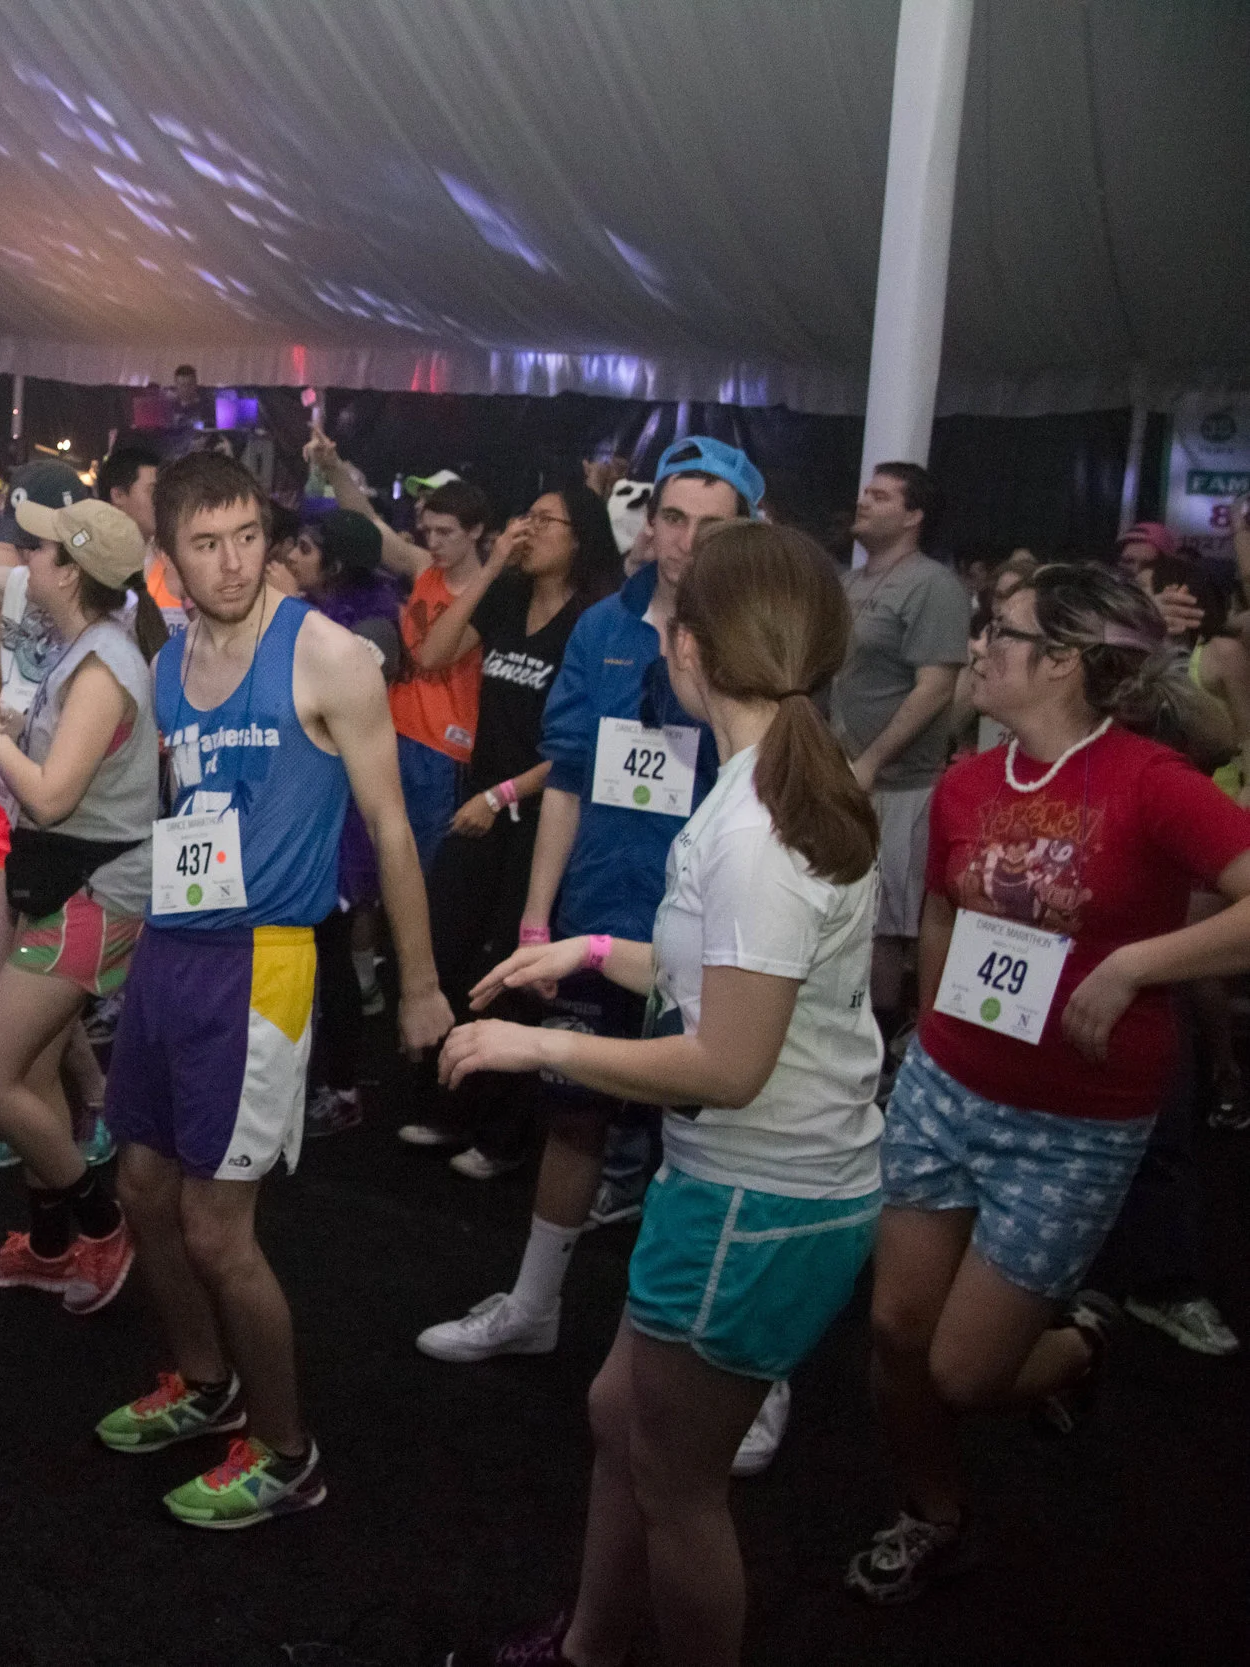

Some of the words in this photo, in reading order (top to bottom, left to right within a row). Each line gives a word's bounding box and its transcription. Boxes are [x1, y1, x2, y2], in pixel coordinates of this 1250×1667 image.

[623, 747, 666, 780] 422
[176, 842, 212, 877] 437
[977, 951, 1028, 995] 429
